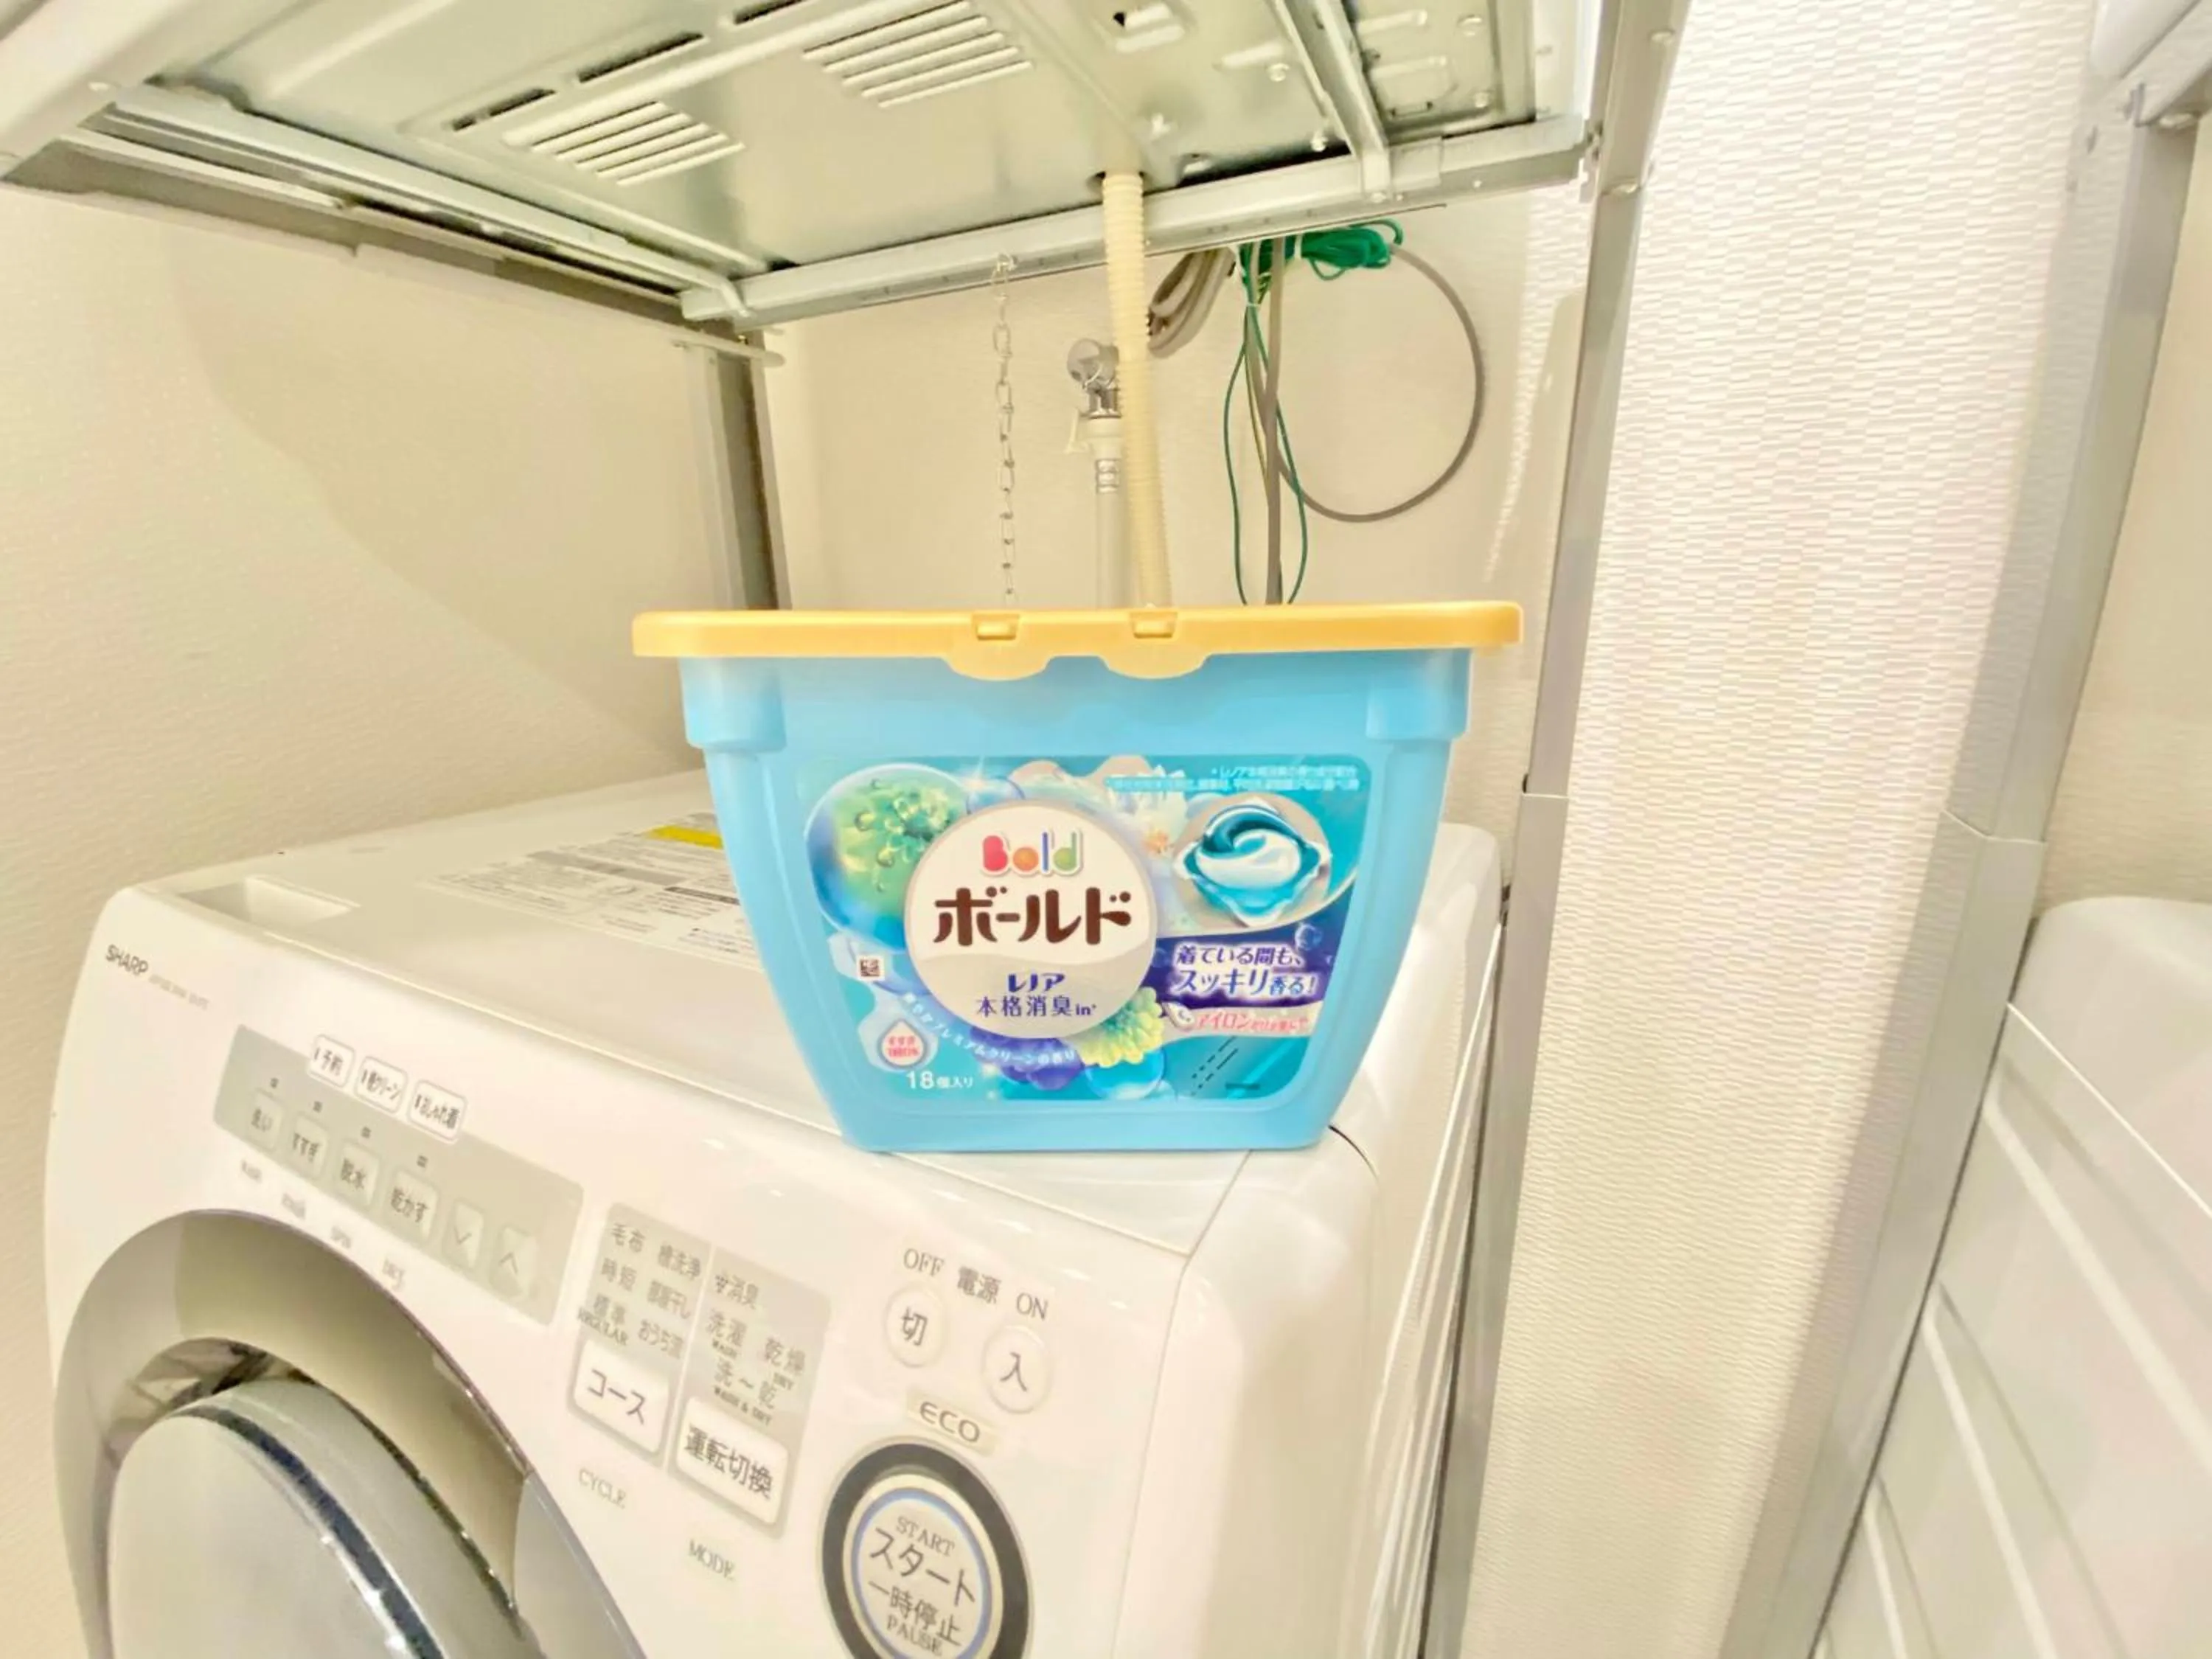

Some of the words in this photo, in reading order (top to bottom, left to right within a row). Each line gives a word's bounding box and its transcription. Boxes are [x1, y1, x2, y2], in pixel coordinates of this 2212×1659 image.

[981, 830, 1079, 873] Bold
[933, 886, 1131, 947] ボールド
[106, 944, 148, 976] SHARP
[1008, 973, 1065, 992] レノア
[904, 1248, 945, 1276] OFF
[957, 1265, 1002, 1304] 電源
[901, 1307, 928, 1346] 切
[1016, 1293, 1048, 1320] ON
[1000, 1352, 1028, 1392] 入
[588, 1368, 645, 1425] コース
[919, 1401, 981, 1443] ECO
[685, 1423, 773, 1500] 運転切換
[579, 1468, 627, 1509] CYCLE
[897, 1516, 956, 1557] START
[689, 1539, 735, 1581] MODE
[870, 1527, 975, 1607] スタート
[868, 1581, 961, 1646] 一時停止
[887, 1614, 943, 1656] PAUSE
